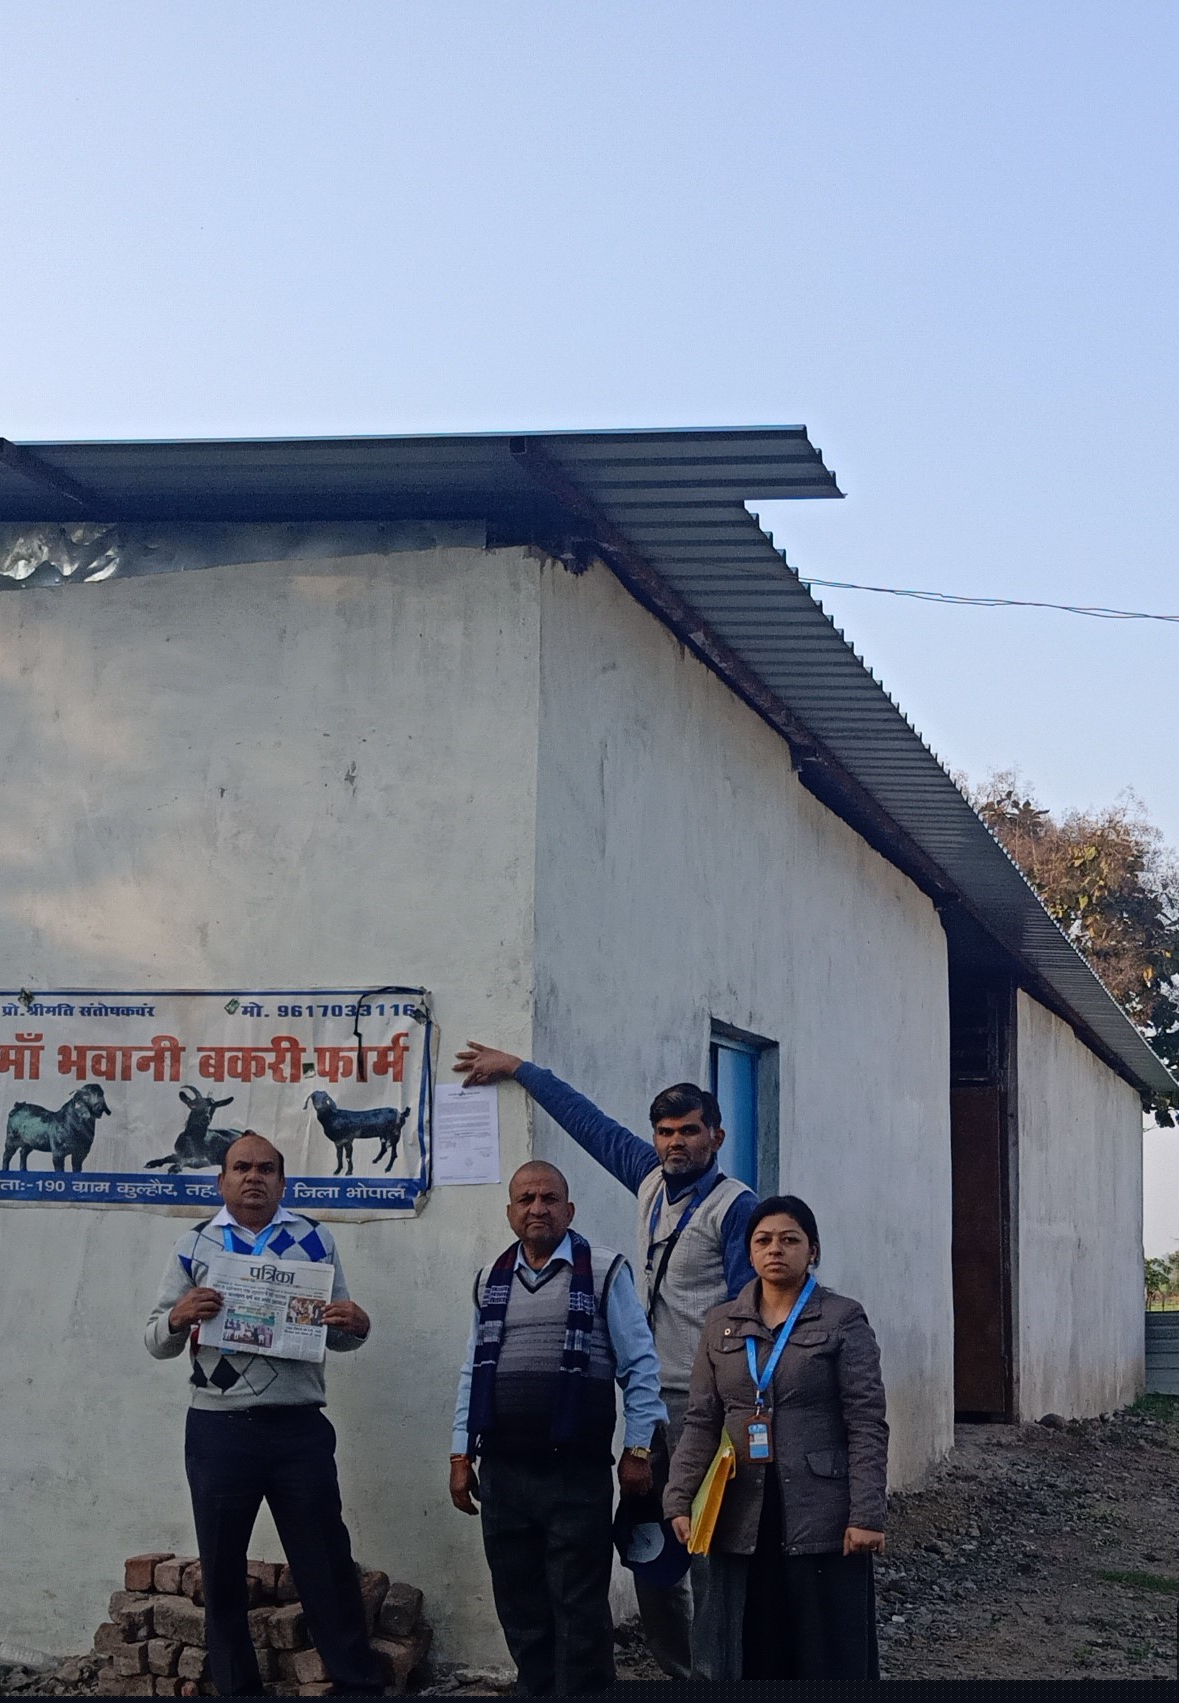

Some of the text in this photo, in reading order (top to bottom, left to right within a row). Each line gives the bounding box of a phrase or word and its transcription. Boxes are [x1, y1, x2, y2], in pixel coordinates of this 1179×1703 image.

[240, 1001, 415, 1018] मो. 9617033116
[57, 1034, 186, 1082] भवानी
[196, 1035, 307, 1083] बकरी
[313, 1032, 410, 1083] फार्म
[72, 1181, 111, 1194] ग्राम
[293, 1181, 341, 1199] जिला
[345, 1182, 406, 1200] भोपाल
[249, 1264, 296, 1285] पत्रिका
